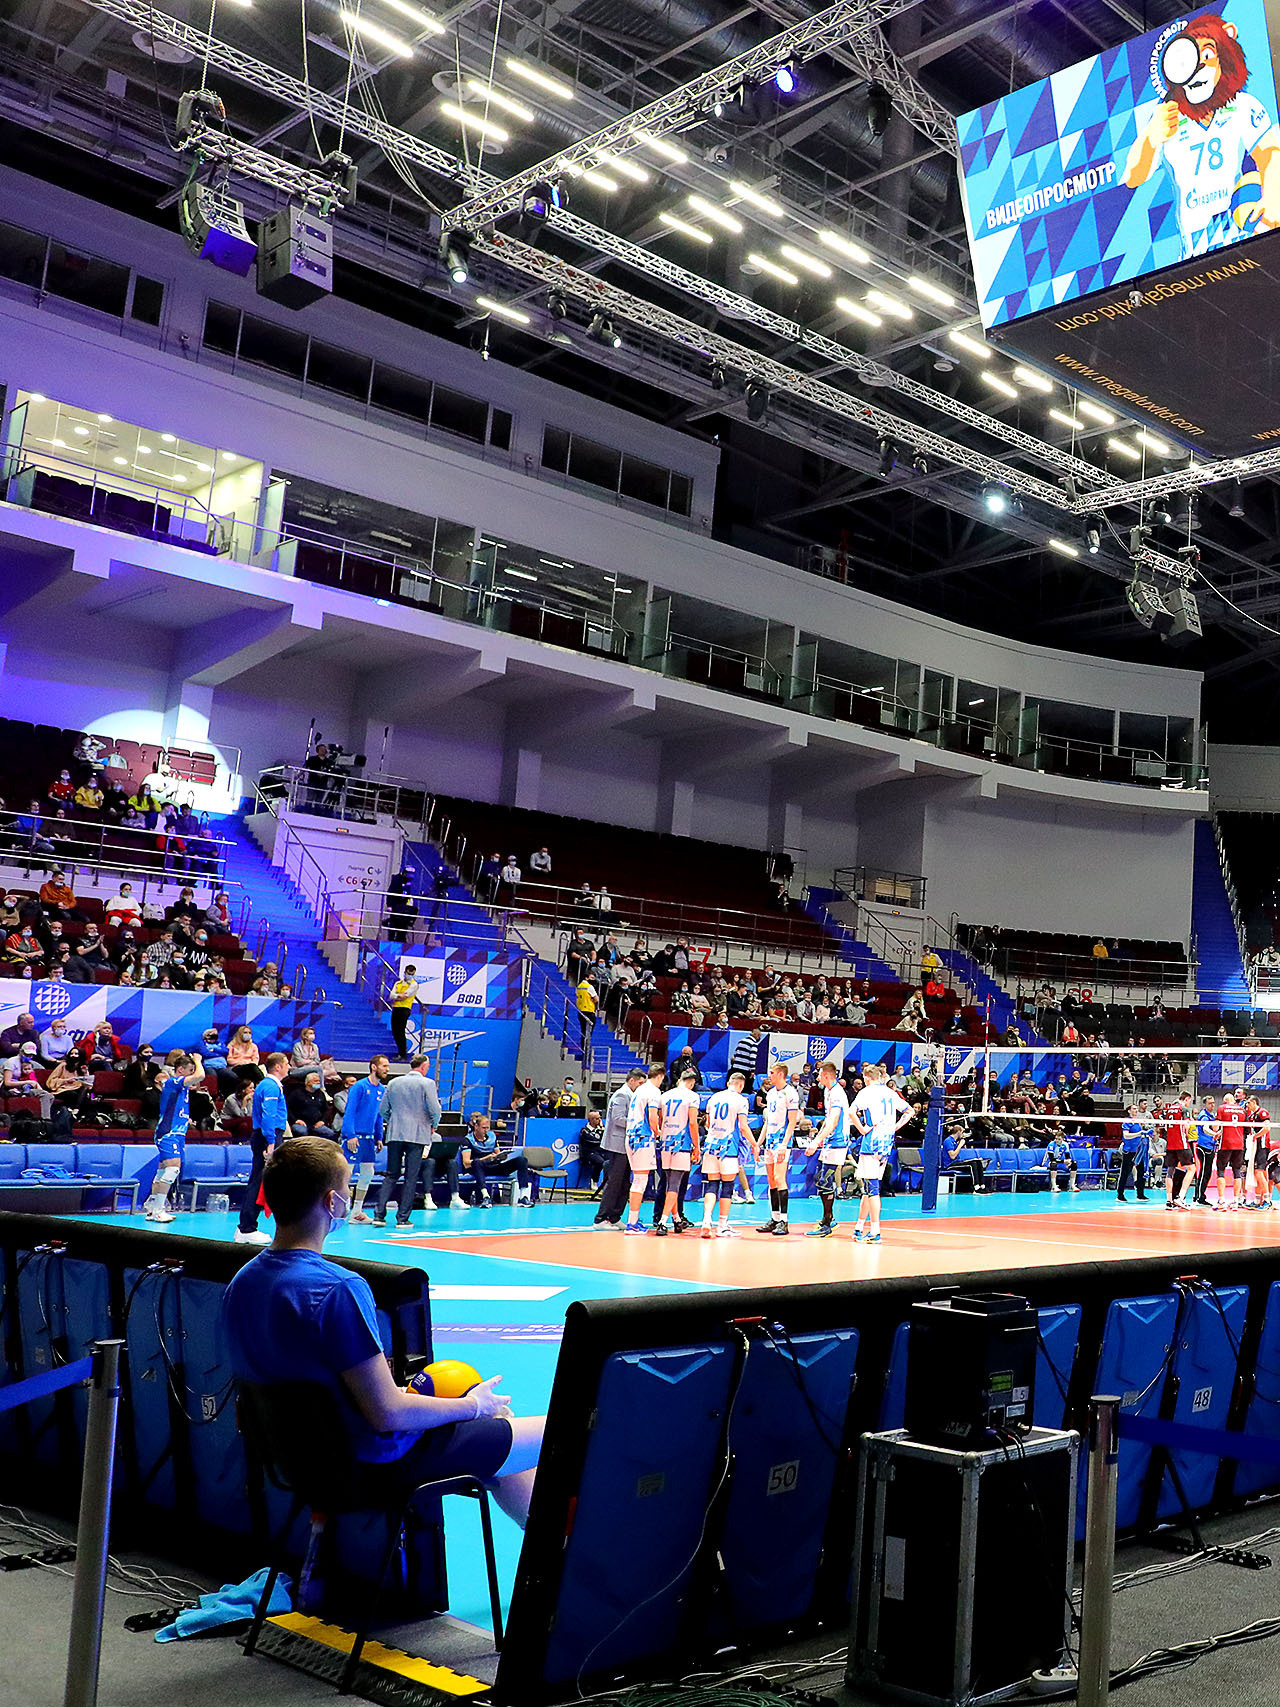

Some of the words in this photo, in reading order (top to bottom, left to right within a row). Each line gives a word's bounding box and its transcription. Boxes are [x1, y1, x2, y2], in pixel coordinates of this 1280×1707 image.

[1189, 137, 1224, 176] 78
[985, 161, 1117, 230] ВИДЕОПРОСМОТР
[1053, 351, 1206, 437] www.megaluxltd.com
[457, 993, 483, 1005] ВФВ
[665, 1098, 683, 1118] 17
[714, 1101, 730, 1120] 10
[880, 1097, 893, 1116] 11
[203, 1397, 215, 1417] 52
[1194, 1390, 1210, 1409] 48
[769, 1464, 797, 1491] 50
